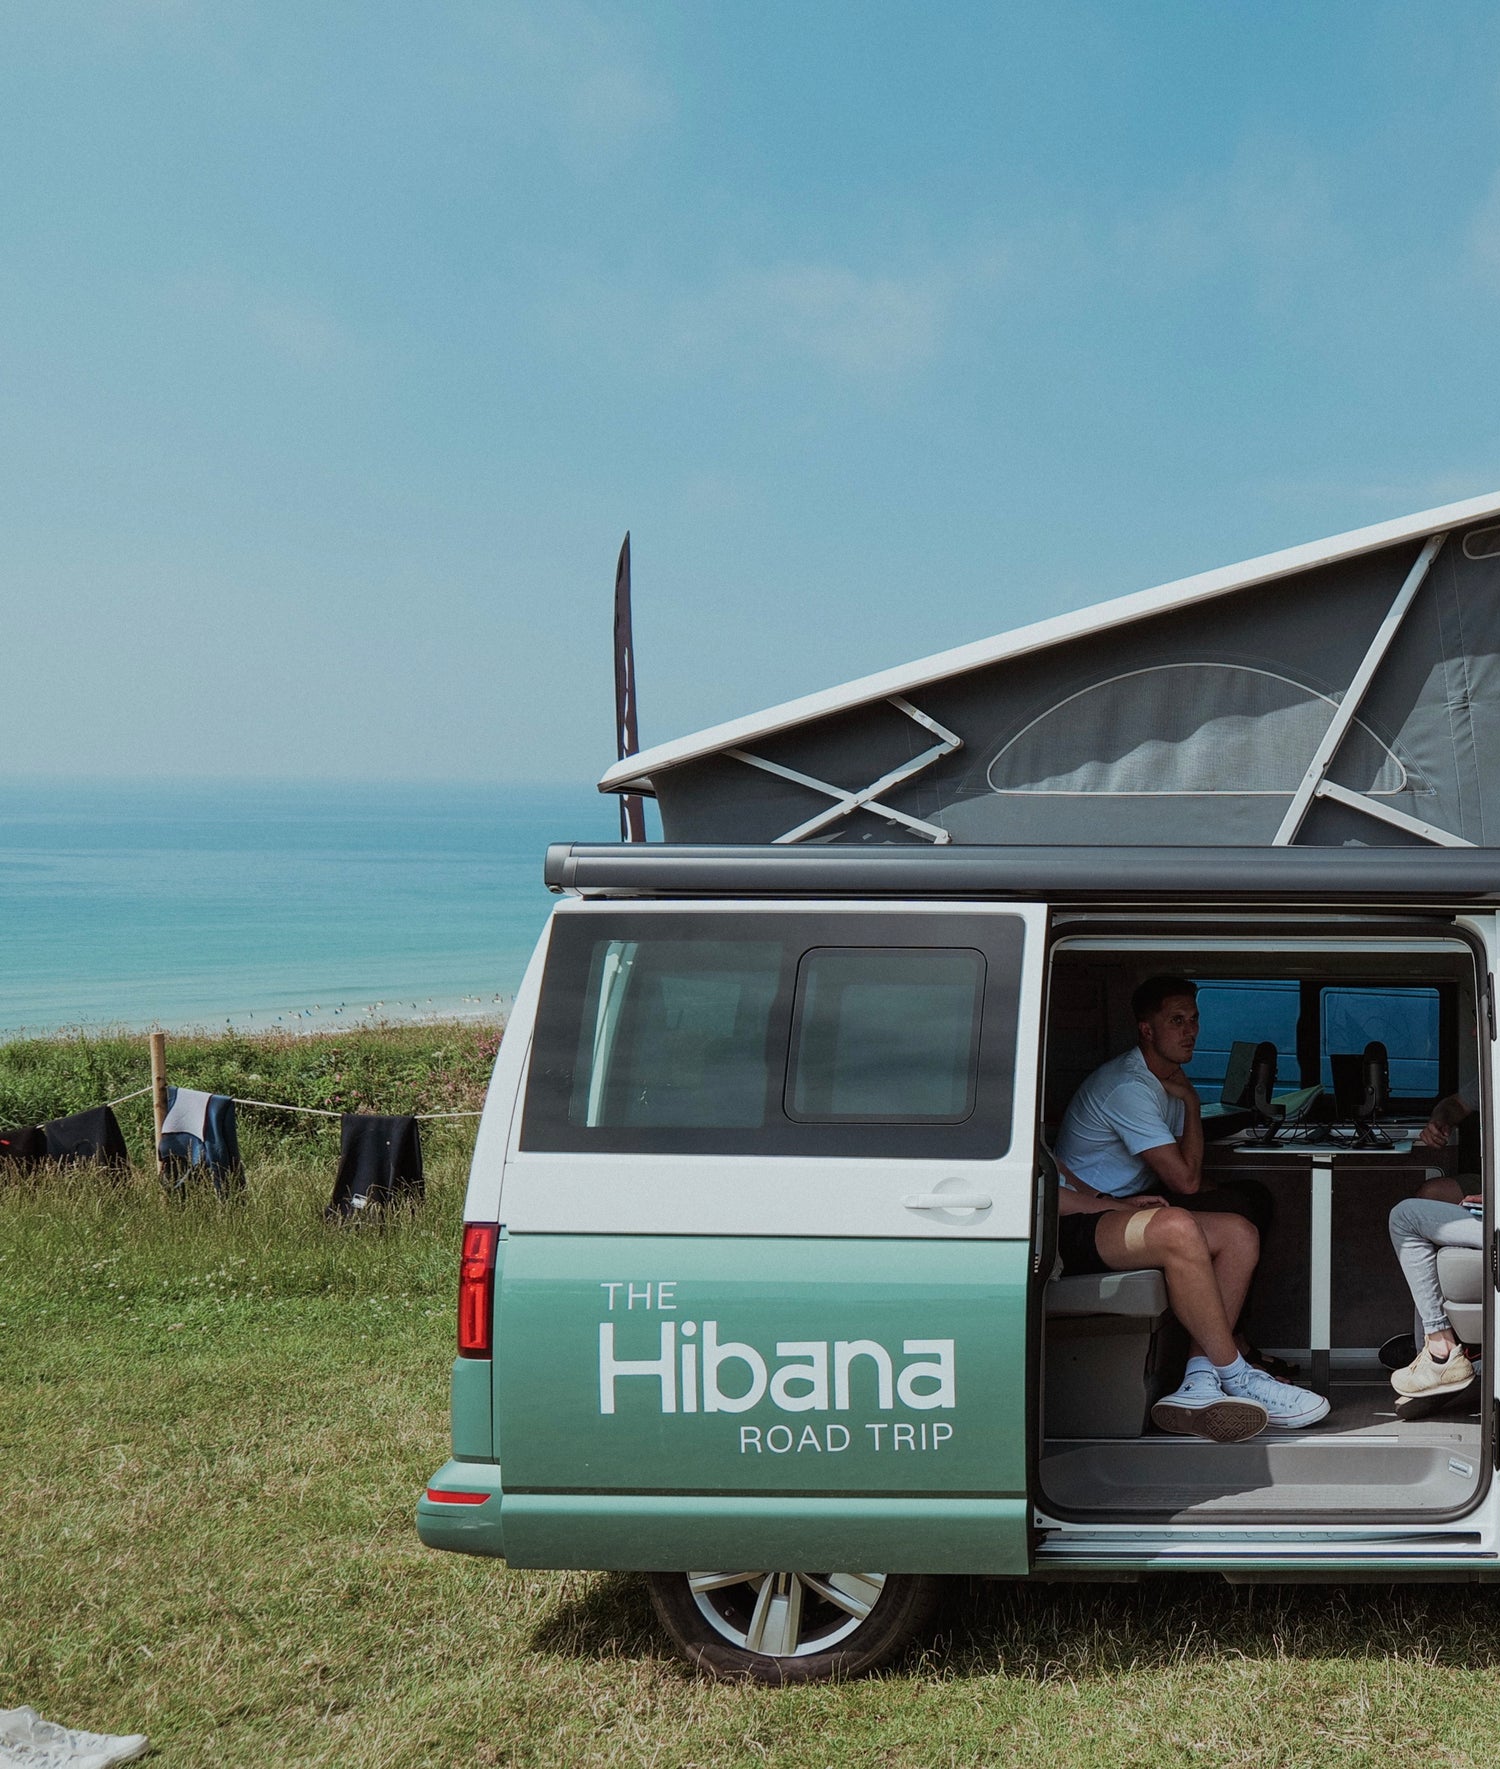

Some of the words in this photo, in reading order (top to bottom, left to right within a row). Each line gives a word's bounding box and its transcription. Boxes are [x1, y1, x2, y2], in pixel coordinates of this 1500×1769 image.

[600, 1281, 678, 1311] THE
[599, 1320, 956, 1415] Hibana
[740, 1424, 851, 1454] ROAD
[865, 1422, 954, 1452] TRIP
